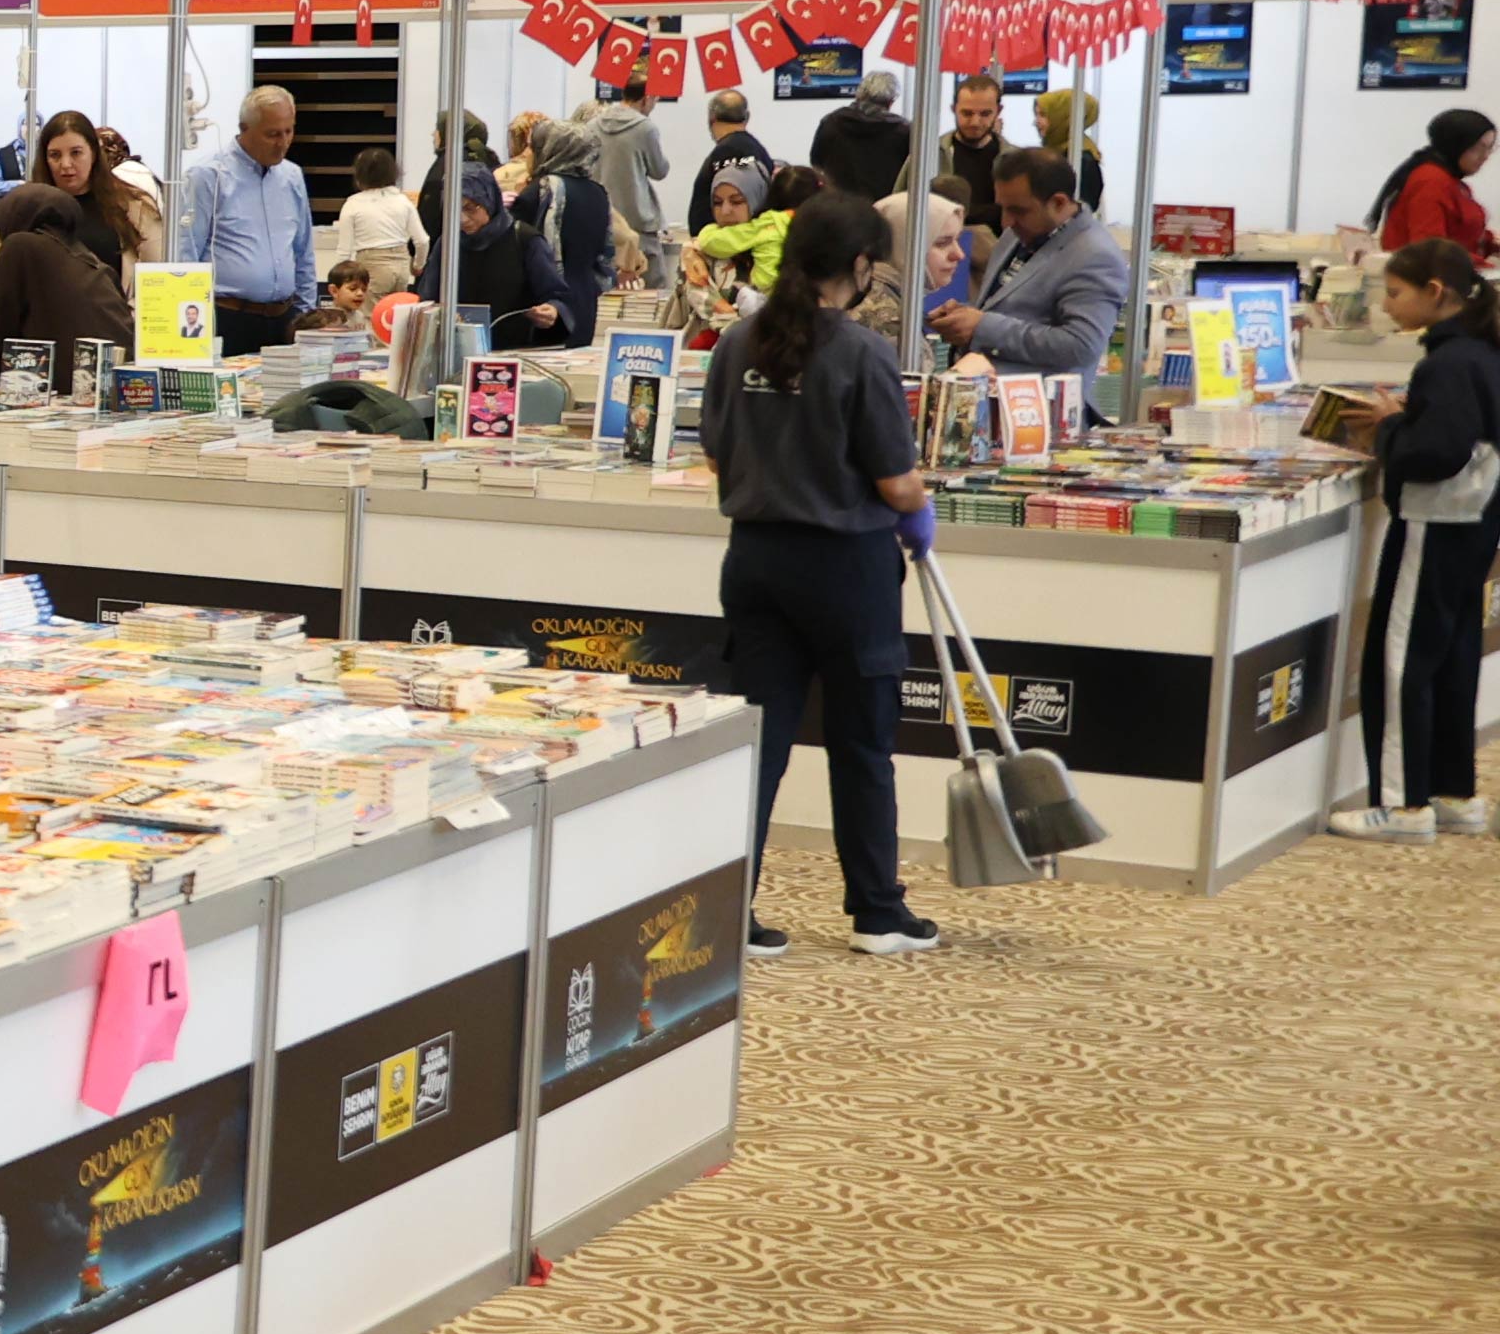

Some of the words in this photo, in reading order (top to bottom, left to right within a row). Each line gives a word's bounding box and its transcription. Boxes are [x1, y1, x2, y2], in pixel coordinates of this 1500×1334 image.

[616, 345, 663, 362] FUARA
[531, 616, 644, 637] OKUMADIĞIN
[562, 651, 682, 681] KARANLIKTASIN
[901, 680, 940, 696] ENİM
[901, 695, 940, 710] EHRİM
[566, 1028, 591, 1057] KİTAP
[344, 1084, 377, 1117] BENİM
[343, 1107, 376, 1139] ŞEHRİM
[79, 1113, 174, 1187] OKUMADIĞIN
